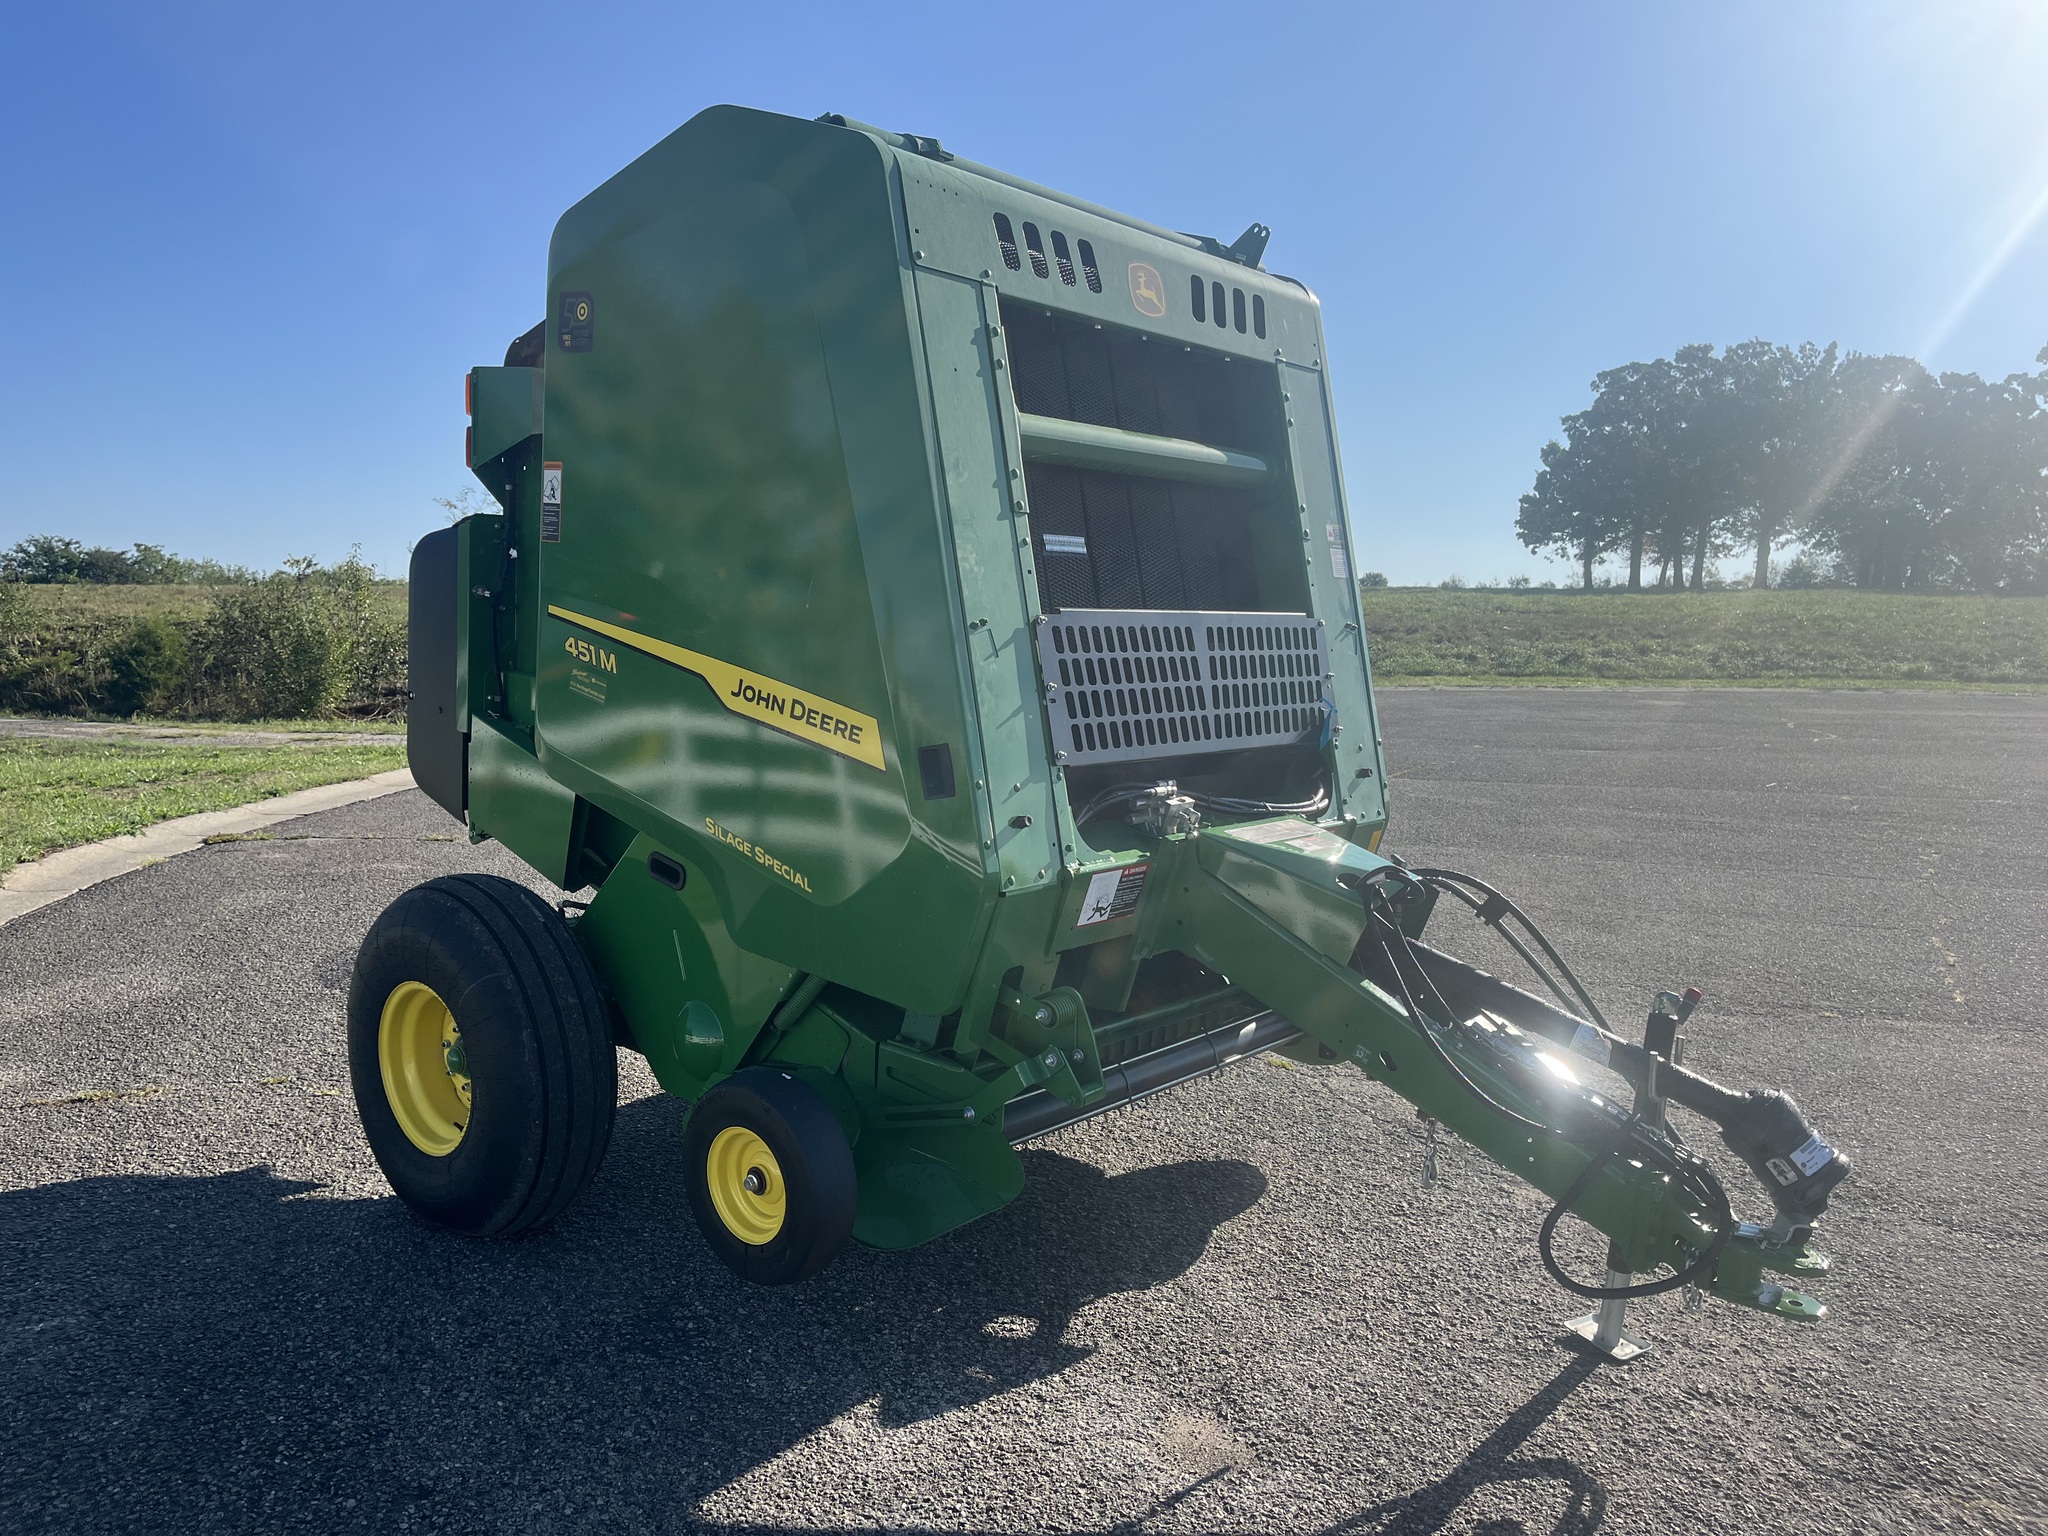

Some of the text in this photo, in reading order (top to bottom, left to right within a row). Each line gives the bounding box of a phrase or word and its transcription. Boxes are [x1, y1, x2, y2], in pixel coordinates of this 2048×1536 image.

[731, 678, 863, 745] JOHN DEERE
[705, 817, 812, 893] SILAGE SPECIAL
